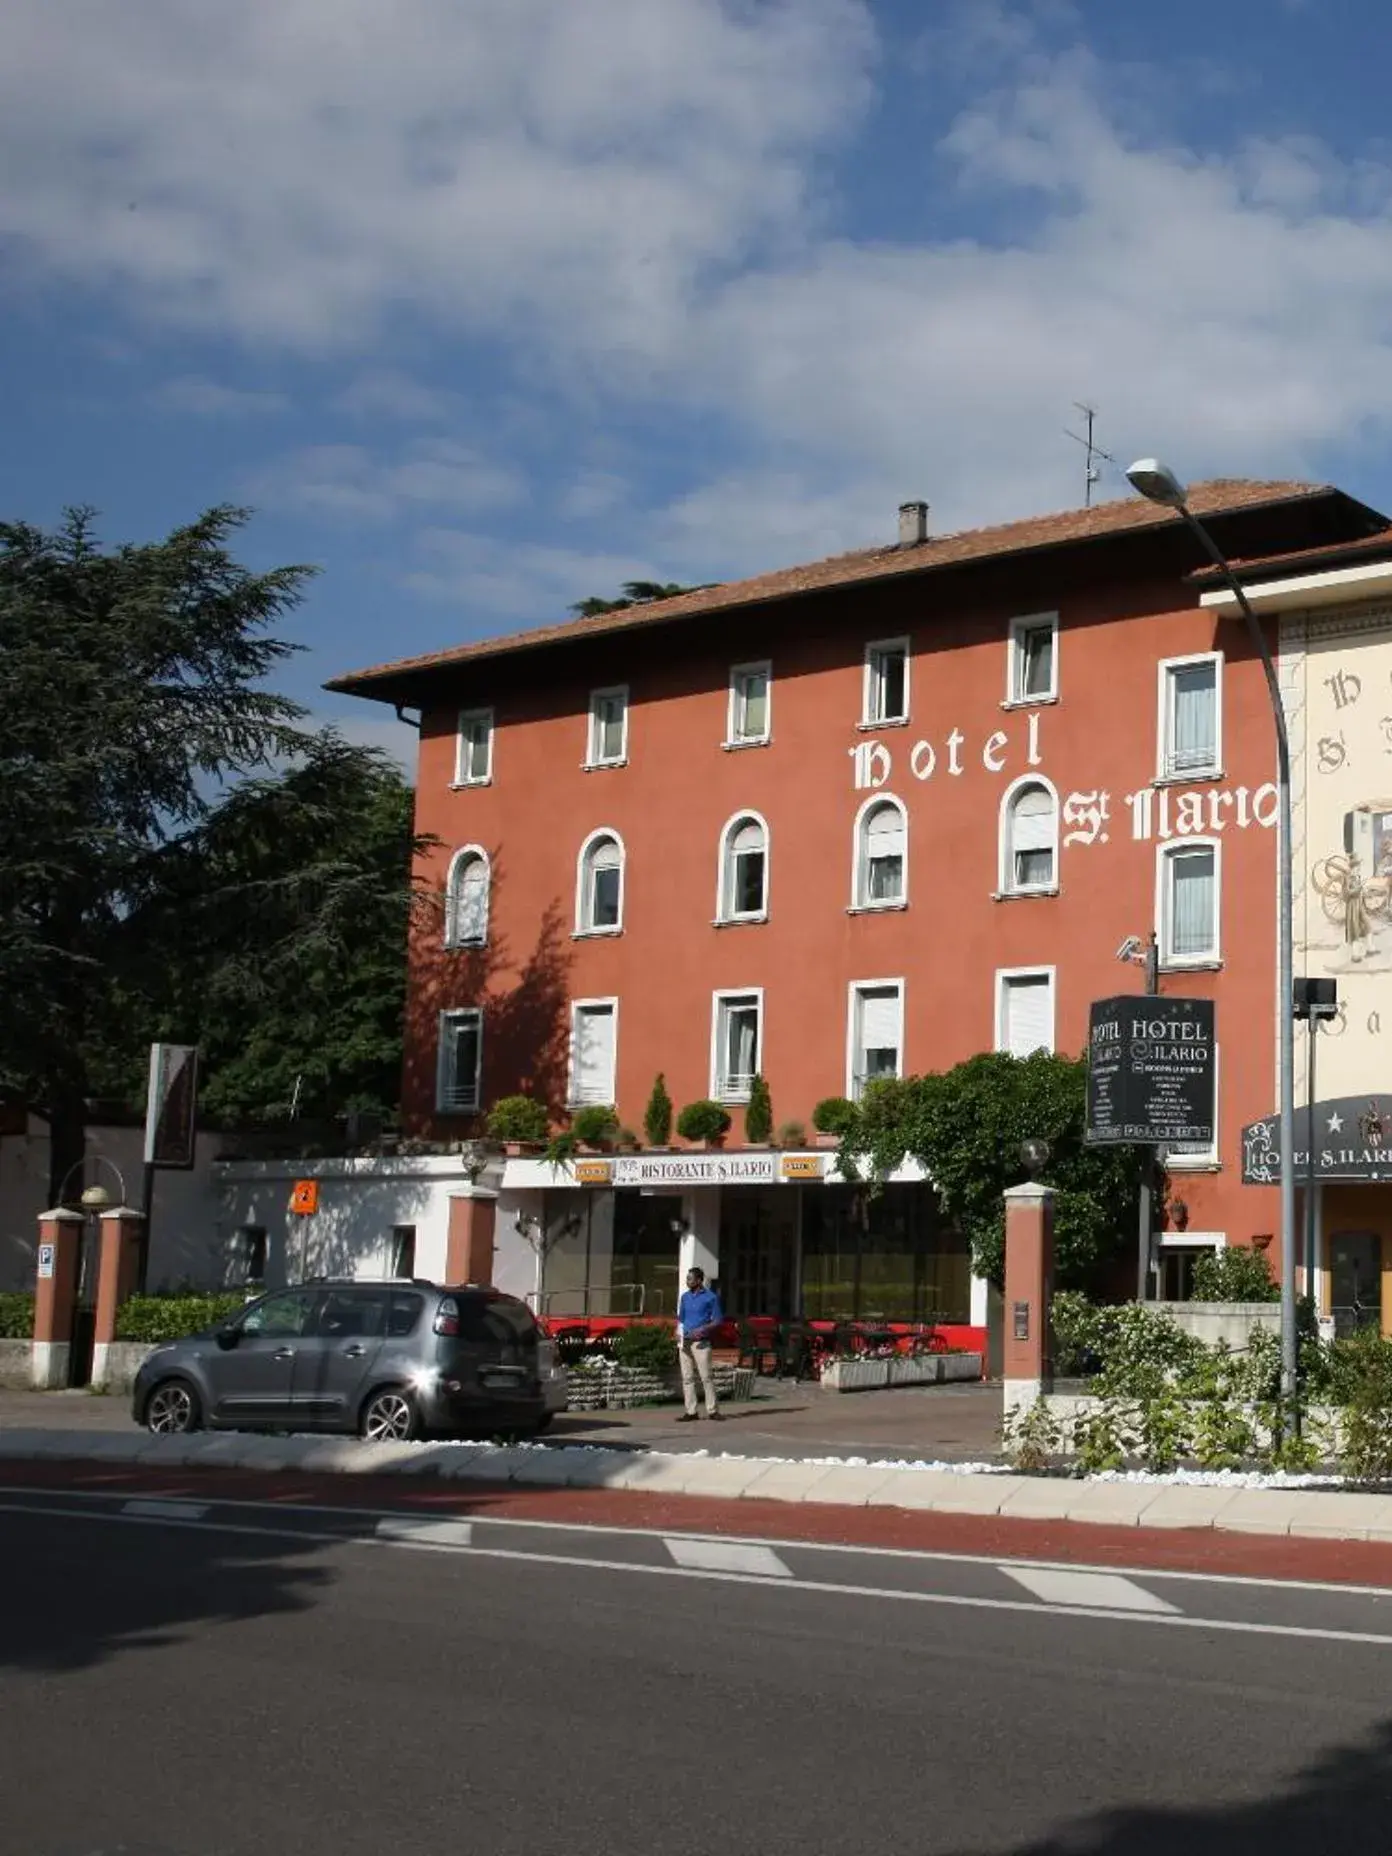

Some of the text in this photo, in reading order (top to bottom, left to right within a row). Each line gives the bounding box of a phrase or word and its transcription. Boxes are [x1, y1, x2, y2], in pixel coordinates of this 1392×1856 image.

[848, 713, 1043, 789] Hotel
[1131, 1019, 1207, 1041] HOTEL
[1252, 1151, 1316, 1165] HOEL
[641, 1161, 714, 1178] RISTORANTE
[42, 1248, 50, 1264] P
